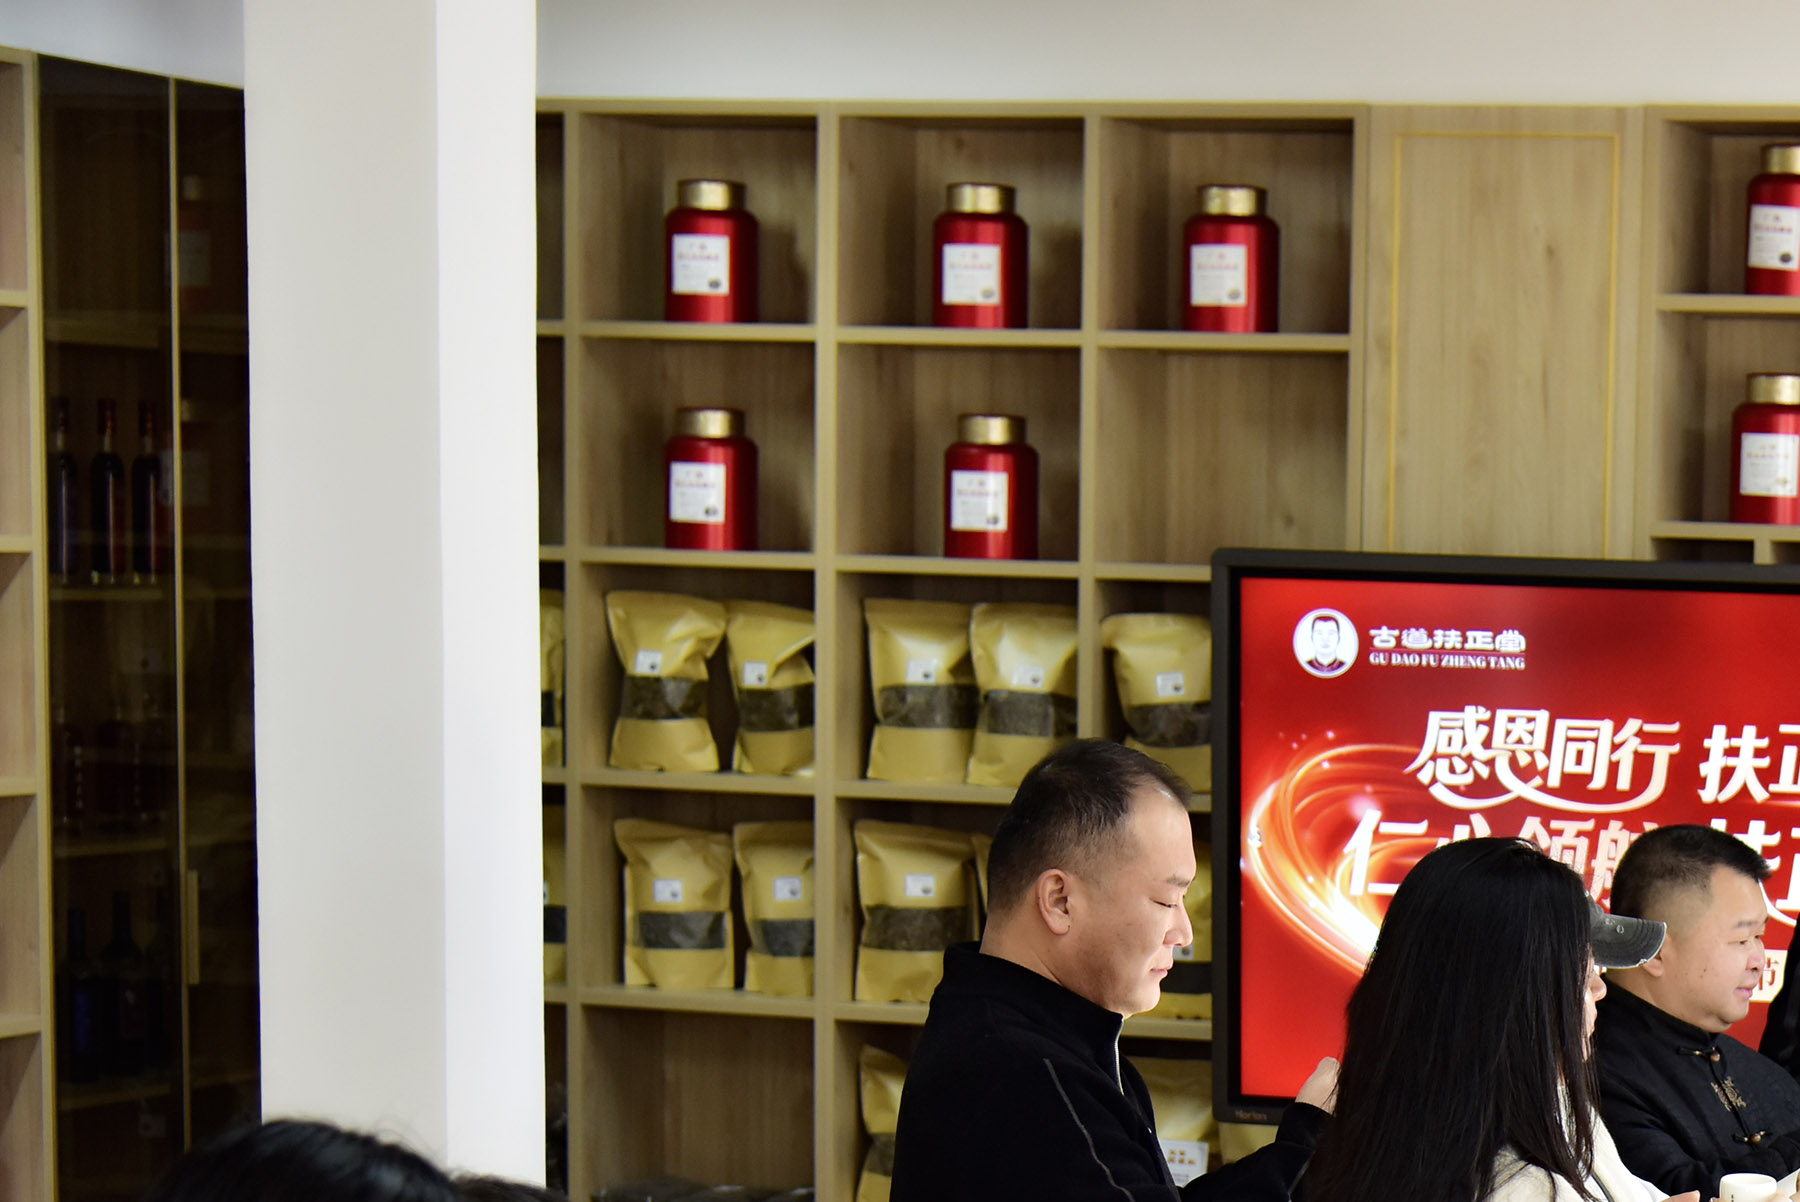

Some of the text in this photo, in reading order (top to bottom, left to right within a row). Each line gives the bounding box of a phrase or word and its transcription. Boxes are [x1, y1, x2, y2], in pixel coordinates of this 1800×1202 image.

[1369, 626, 1526, 653] 古道扶正堂
[1369, 651, 1526, 671] GU DAO FU ZHENG TANG
[1403, 705, 1681, 813] 感恩同行
